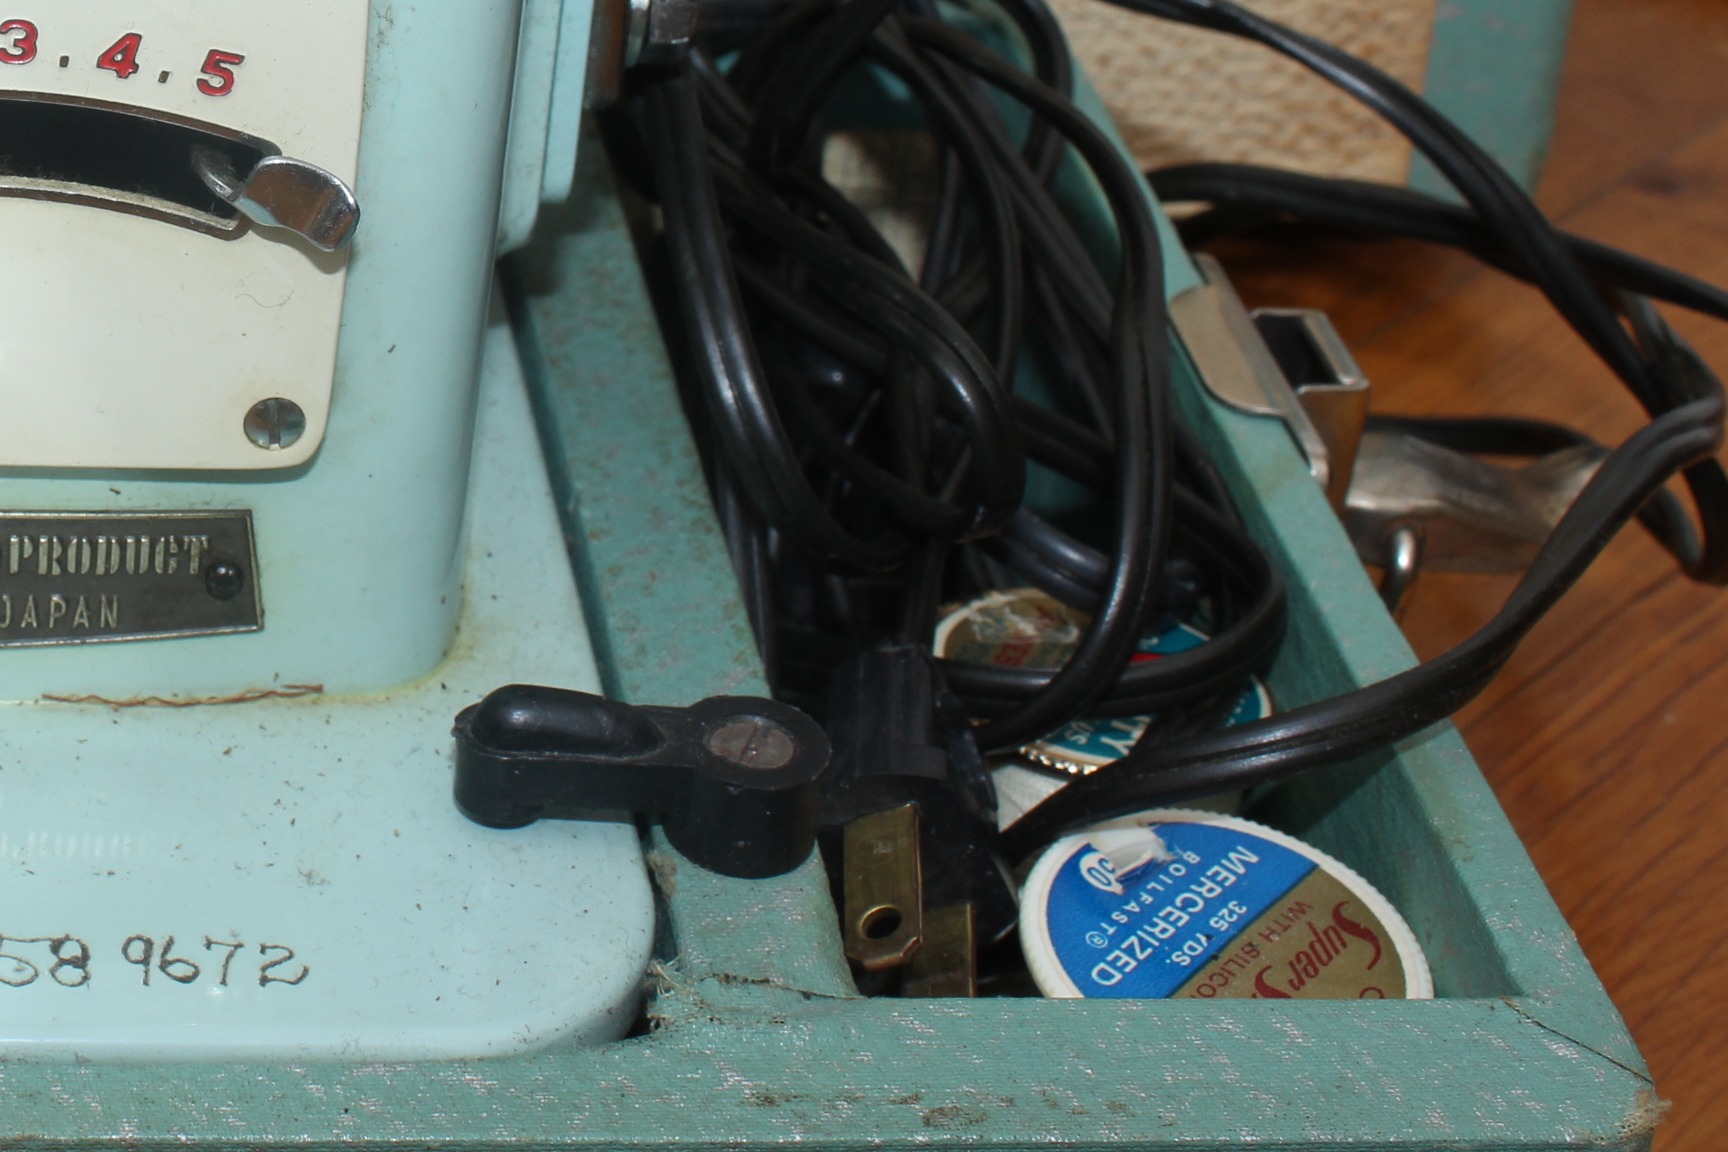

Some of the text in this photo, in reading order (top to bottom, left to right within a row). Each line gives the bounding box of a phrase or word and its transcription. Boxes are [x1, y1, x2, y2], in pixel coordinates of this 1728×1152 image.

[96, 31, 143, 80] 4
[195, 48, 246, 97] 5
[9, 534, 210, 577] PRODUCT
[1091, 845, 1261, 986] MERCERIZED
[1208, 900, 1248, 933] 325
[1259, 901, 1313, 942] WITH
[121, 933, 310, 987] 9672
[1191, 942, 1262, 999] SILICO
[1287, 900, 1382, 991] Super
